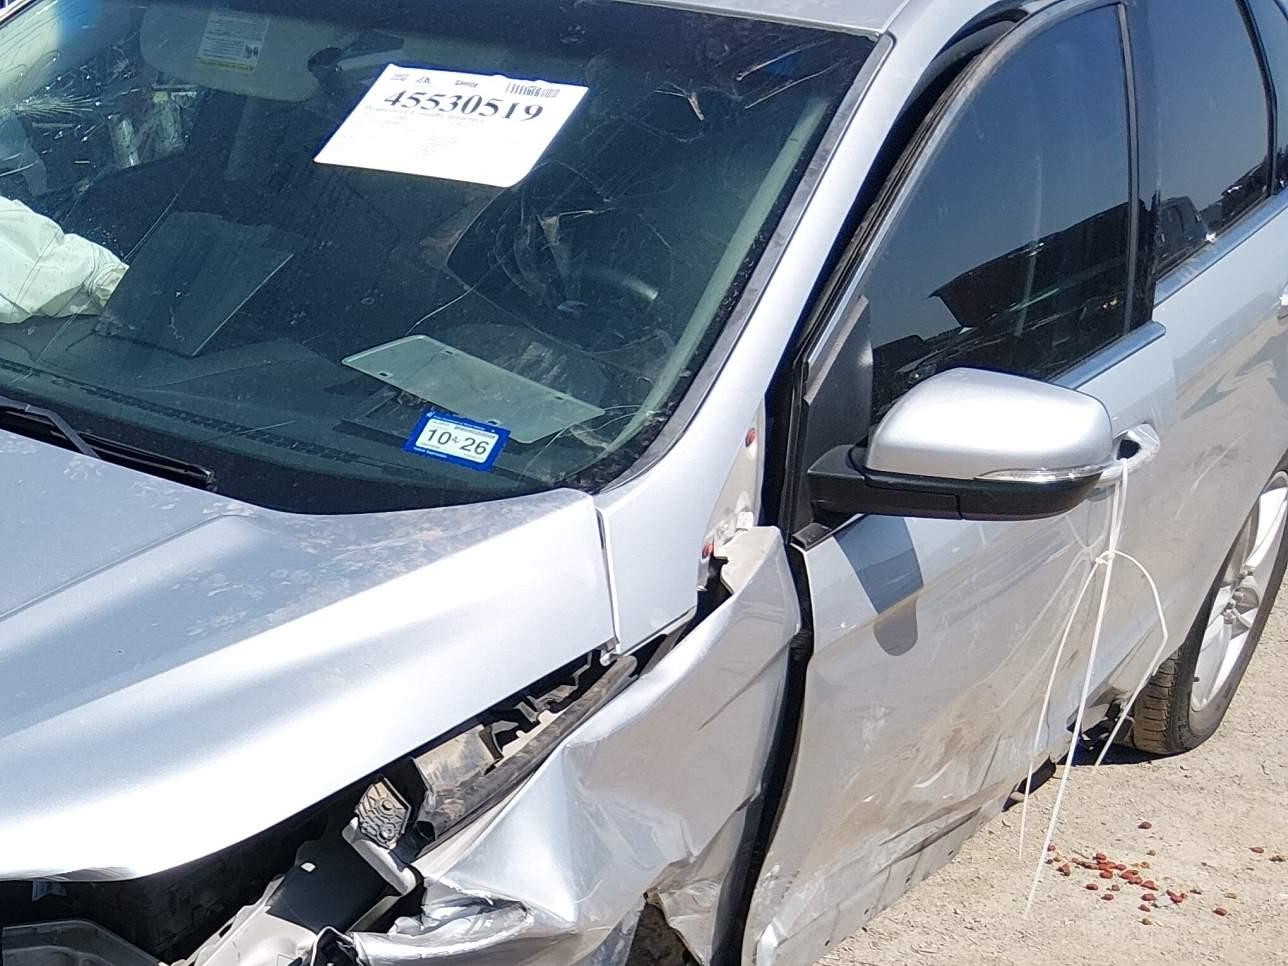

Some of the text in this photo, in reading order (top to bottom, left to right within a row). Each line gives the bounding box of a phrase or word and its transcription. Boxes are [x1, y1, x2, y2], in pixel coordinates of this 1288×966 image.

[384, 89, 543, 121] 45530519
[428, 428, 452, 445] 10
[459, 437, 490, 455] 26
